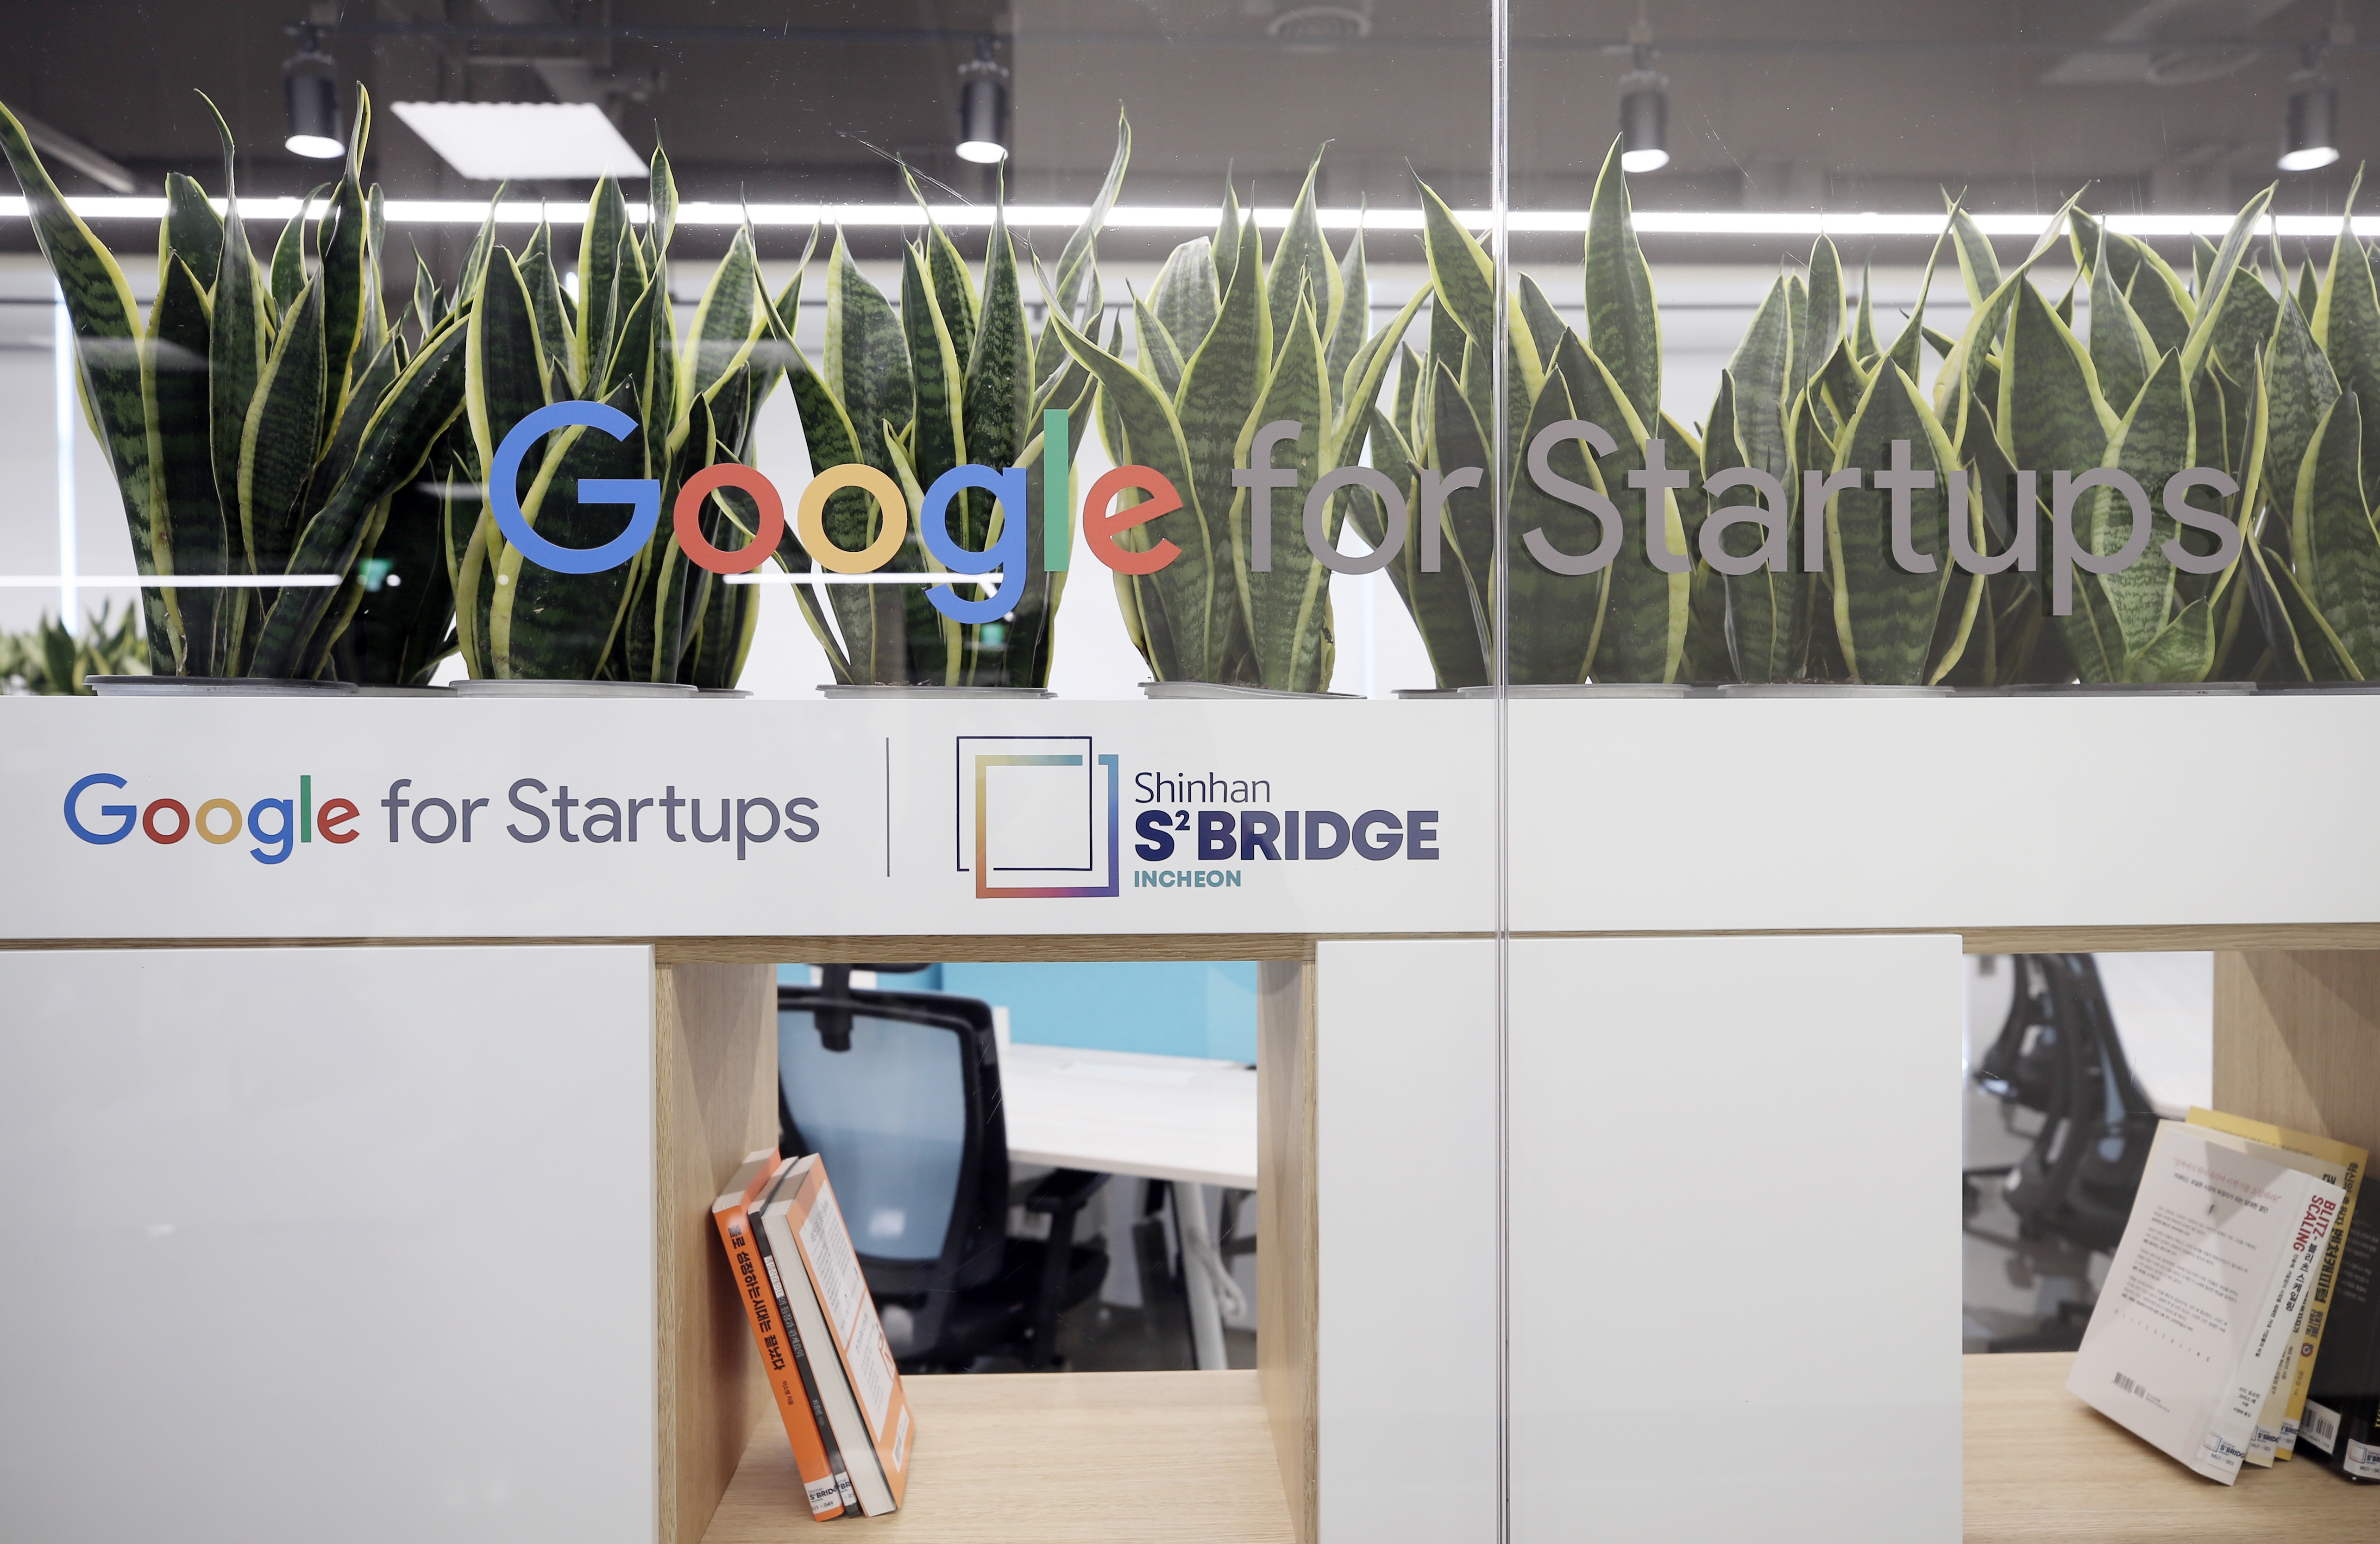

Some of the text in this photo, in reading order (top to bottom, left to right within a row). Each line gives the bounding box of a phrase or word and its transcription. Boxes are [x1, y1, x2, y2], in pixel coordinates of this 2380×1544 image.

[489, 400, 2242, 624] Google for Startups
[1135, 772, 1270, 803] Shinhan
[63, 773, 820, 864] Google for Startups
[1134, 870, 1242, 888] INCHEON
[2293, 1195, 2324, 1252] SCALING
[2312, 1200, 2336, 1241] BLITZ-
[2300, 1243, 2317, 1273] 블리츠
[728, 1225, 746, 1249] 홀로
[764, 1334, 785, 1371] 끝났다
[2286, 1273, 2305, 1312] 스케일링
[780, 1306, 797, 1328] 등장과
[786, 1395, 794, 1405] 지음
